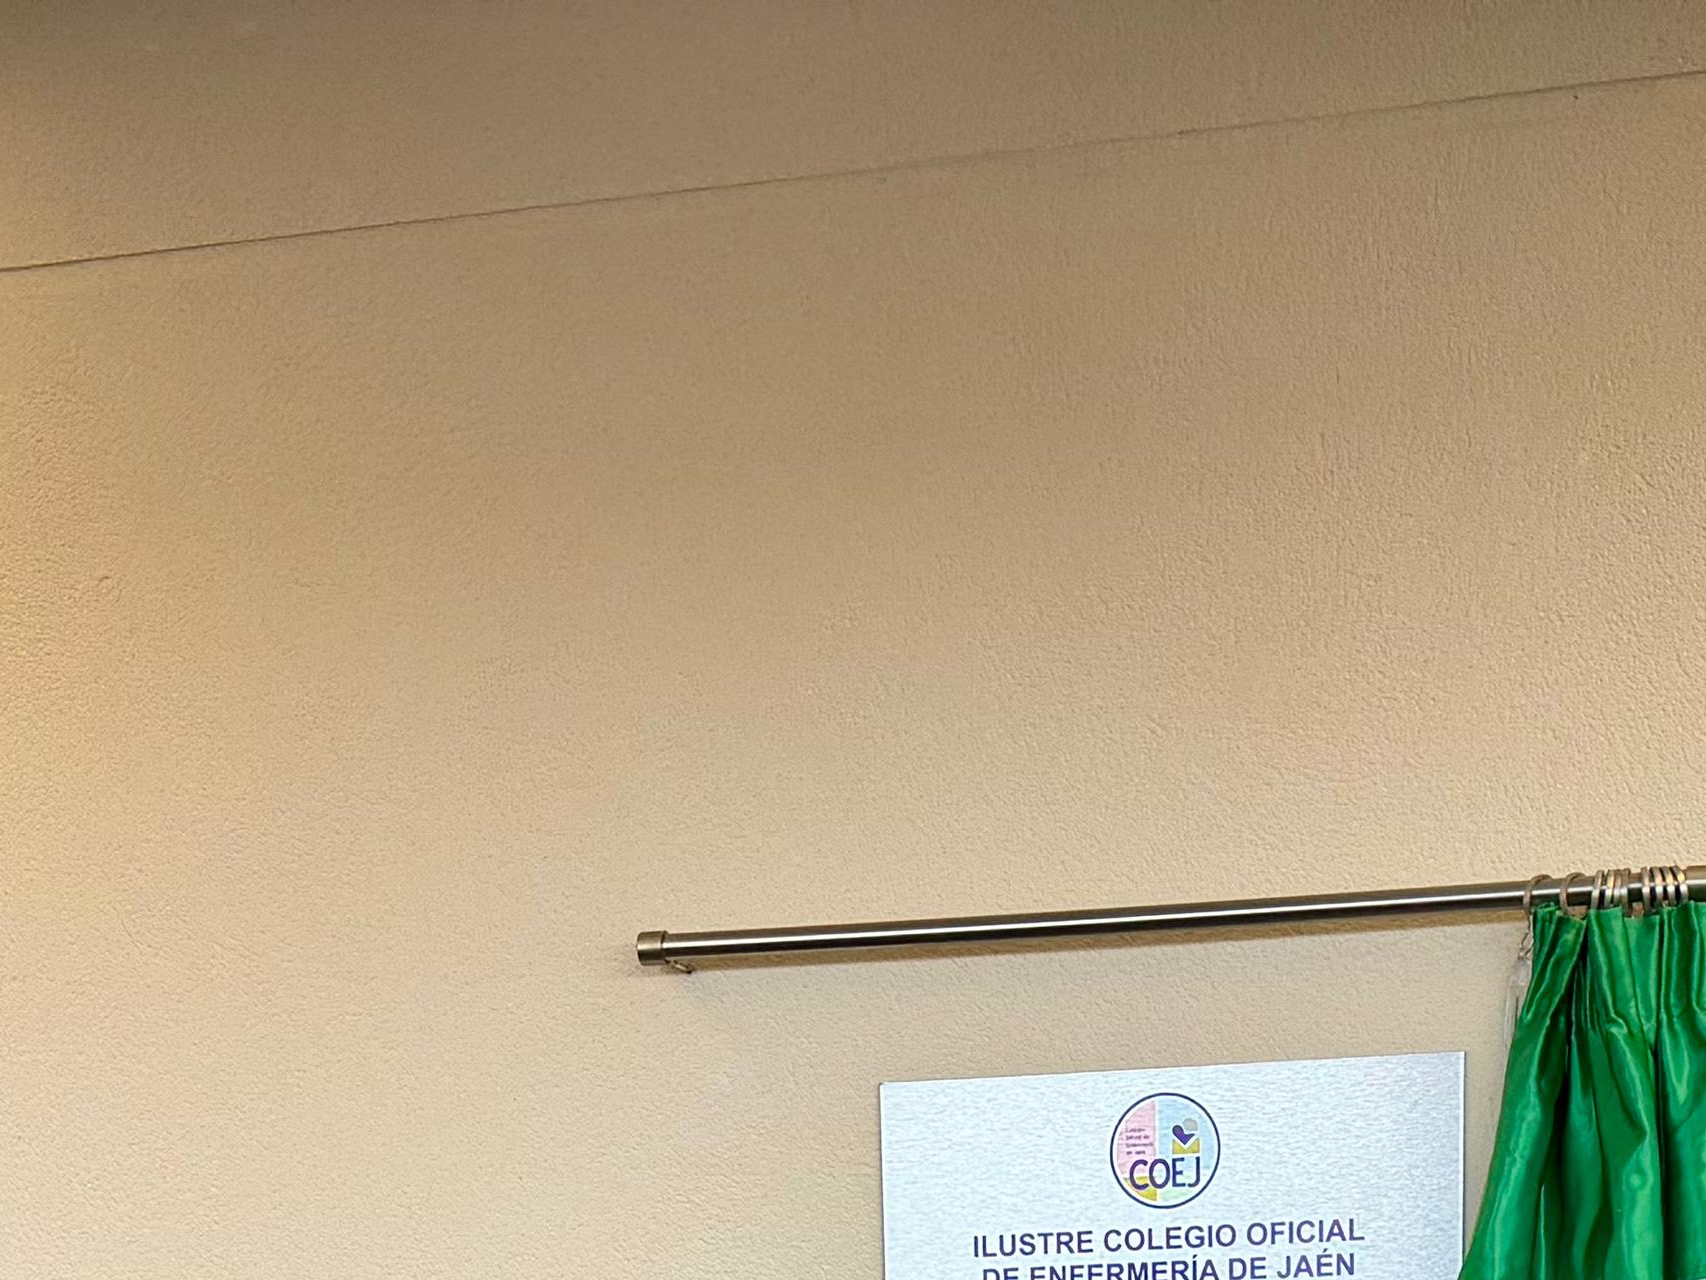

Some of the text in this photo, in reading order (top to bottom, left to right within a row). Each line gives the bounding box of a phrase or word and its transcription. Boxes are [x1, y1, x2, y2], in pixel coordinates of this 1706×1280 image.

[1129, 1156, 1200, 1190] COEJ
[973, 1218, 1365, 1257] ILUSTRE COLEGIO OFICIAL
[1228, 1257, 1267, 1280] DE
[1276, 1248, 1355, 1279] JAÉN
